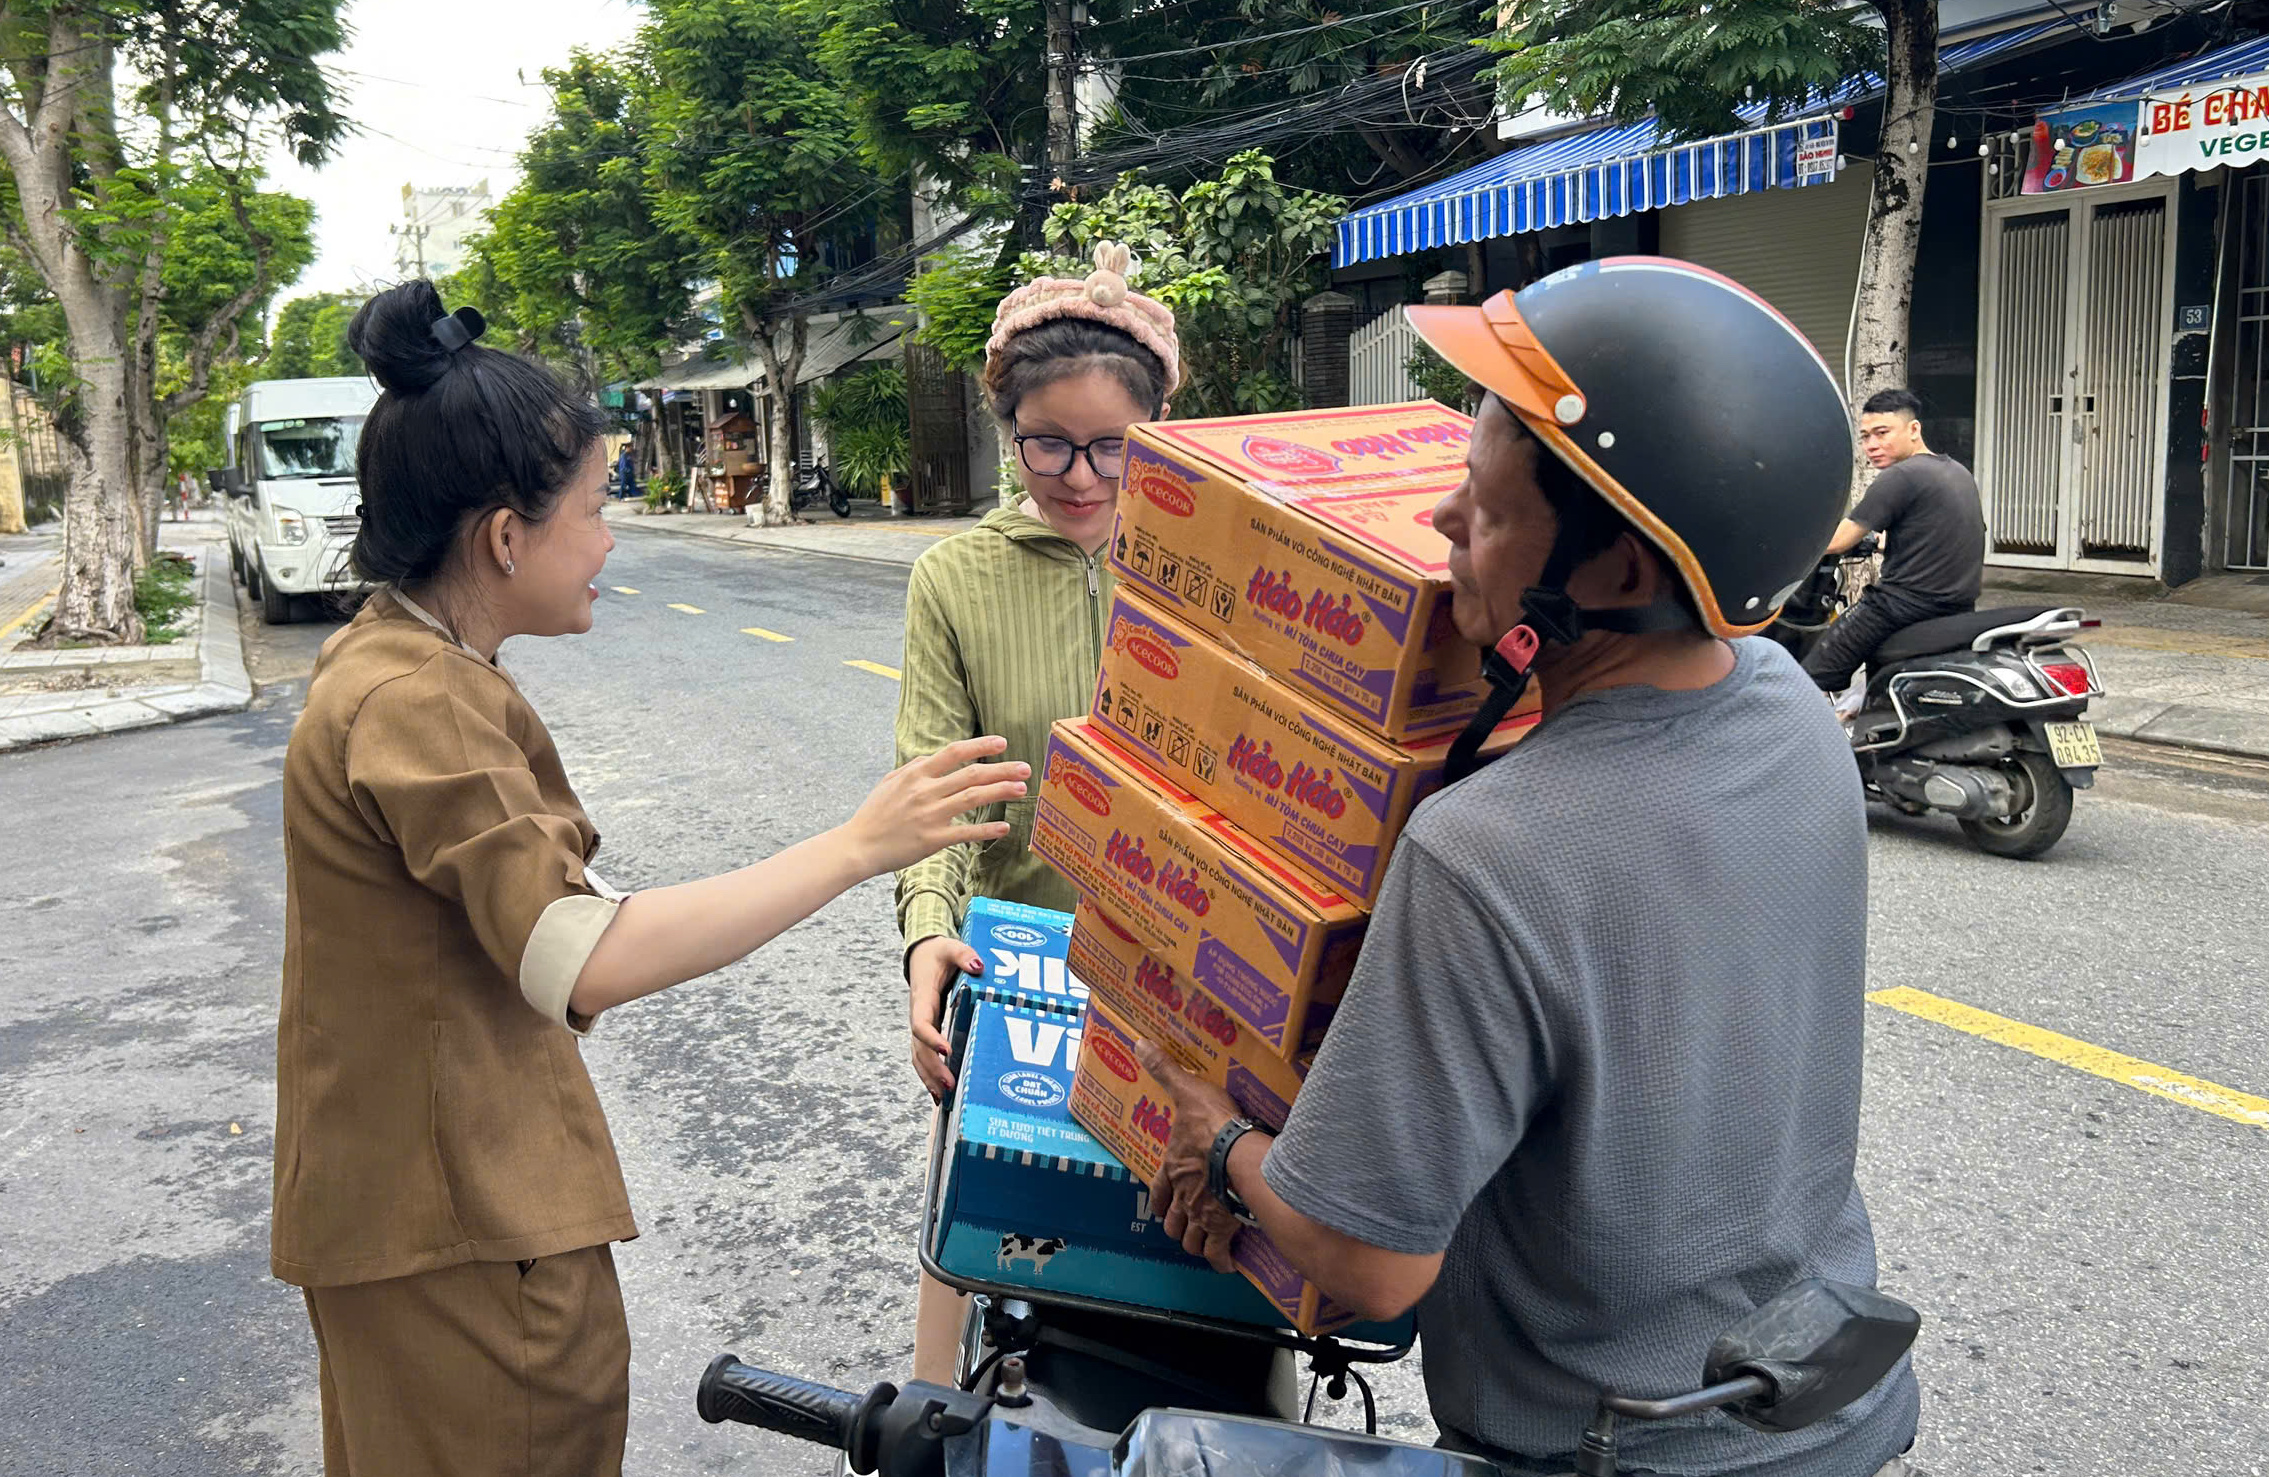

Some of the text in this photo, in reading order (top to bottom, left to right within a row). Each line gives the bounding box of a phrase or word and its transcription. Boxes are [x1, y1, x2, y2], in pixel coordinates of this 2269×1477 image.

[2152, 92, 2192, 135] BÉ
[2186, 308, 2202, 324] 53
[1305, 545, 1330, 569] CÔNG
[1380, 585, 1401, 607] BẢN
[1246, 565, 1303, 621] Hảo
[1303, 588, 1364, 646] Hảo
[1296, 629, 1319, 654] TÔM
[1318, 644, 1343, 668] CHUA
[1344, 659, 1365, 681] CAY
[1226, 732, 1346, 820] Hảo Hảo
[1287, 718, 1312, 743] CÔNG
[1361, 764, 1382, 786] BẢN
[1278, 798, 1300, 823] TÔM
[1300, 814, 1326, 841] CHUA
[1325, 831, 1346, 854] CAY
[1104, 827, 1155, 885] Hảo
[1156, 858, 1211, 917] Hảo
[1208, 864, 1230, 890] CÔNG
[1173, 914, 1189, 935] CAY
[1131, 1094, 1173, 1147] Hả
[1131, 1221, 1146, 1233] EST
